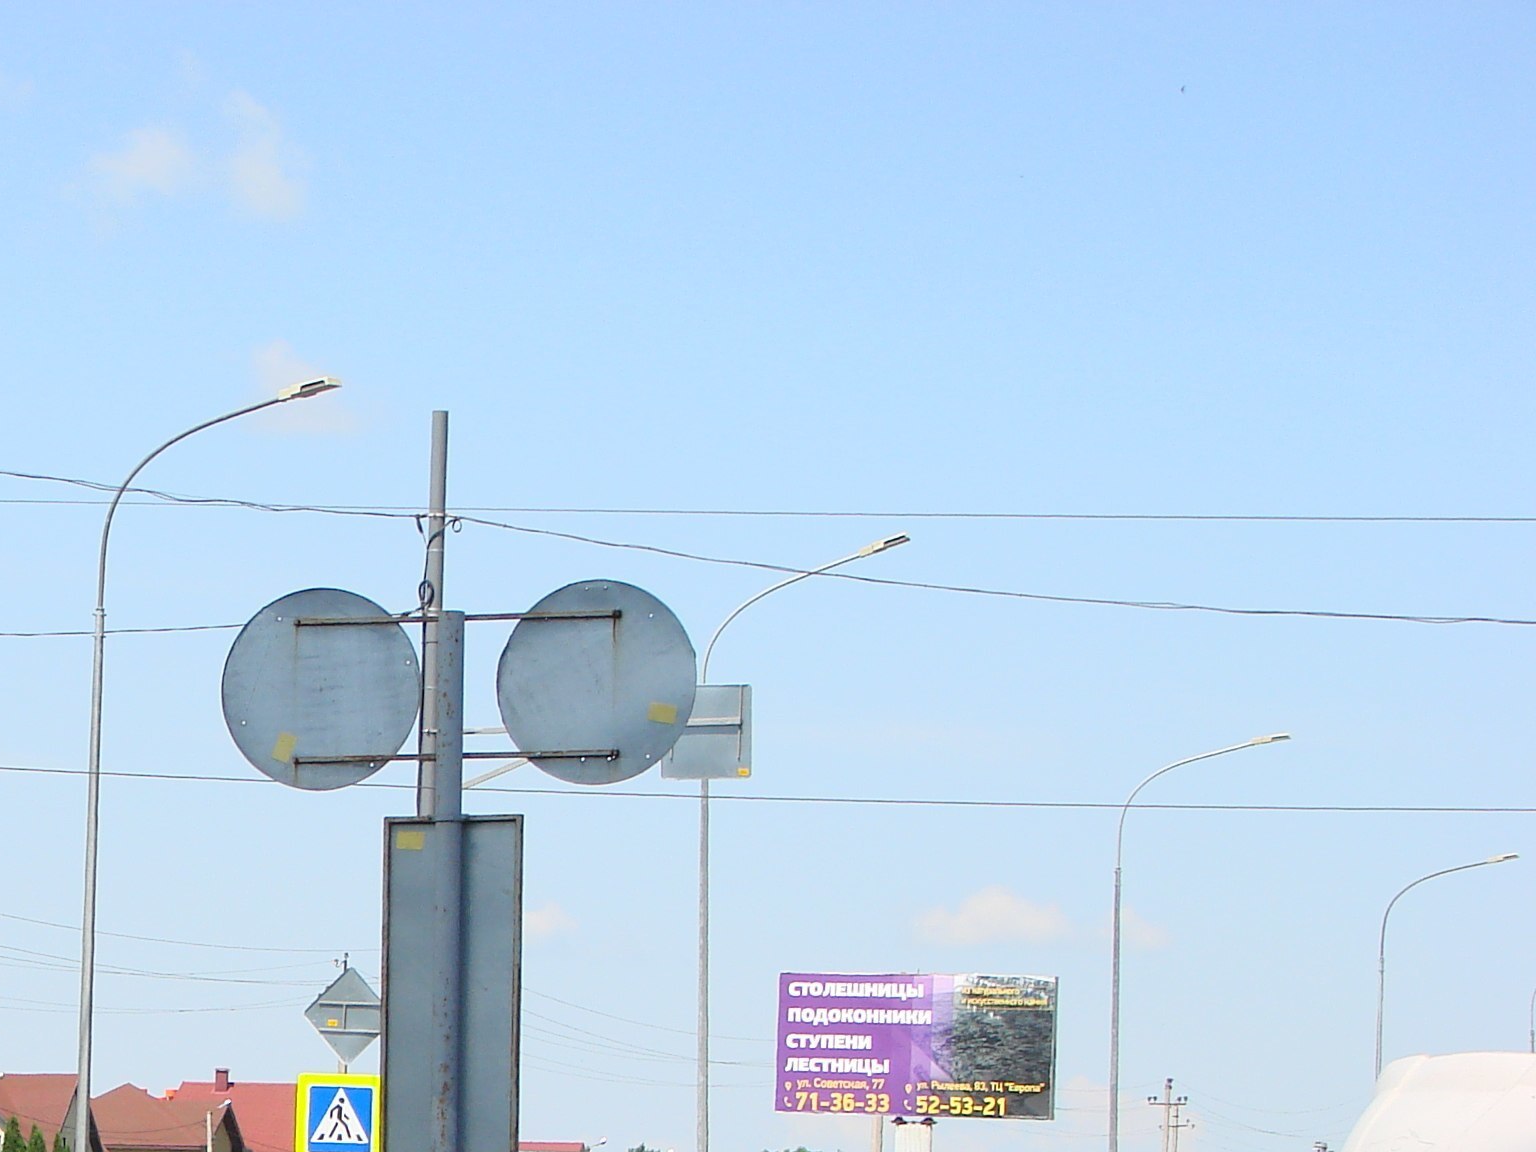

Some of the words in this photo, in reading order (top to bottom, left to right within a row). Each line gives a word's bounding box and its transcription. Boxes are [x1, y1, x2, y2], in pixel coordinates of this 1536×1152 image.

[788, 981, 925, 1001] СТОЛЕШНИЦЫ
[787, 1007, 933, 1026] ПОДОКОННИКИ
[785, 1033, 873, 1050] СТУПЕНИ
[784, 1057, 890, 1077] ЛЕСТНИЦЫ
[796, 1079, 811, 1090] ул.
[813, 1077, 870, 1091] Советская,
[871, 1078, 885, 1090] 77
[990, 1081, 1004, 1093] ТЦ
[795, 1091, 890, 1113] 71-36-33
[915, 1095, 1006, 1116] 52-53-21
